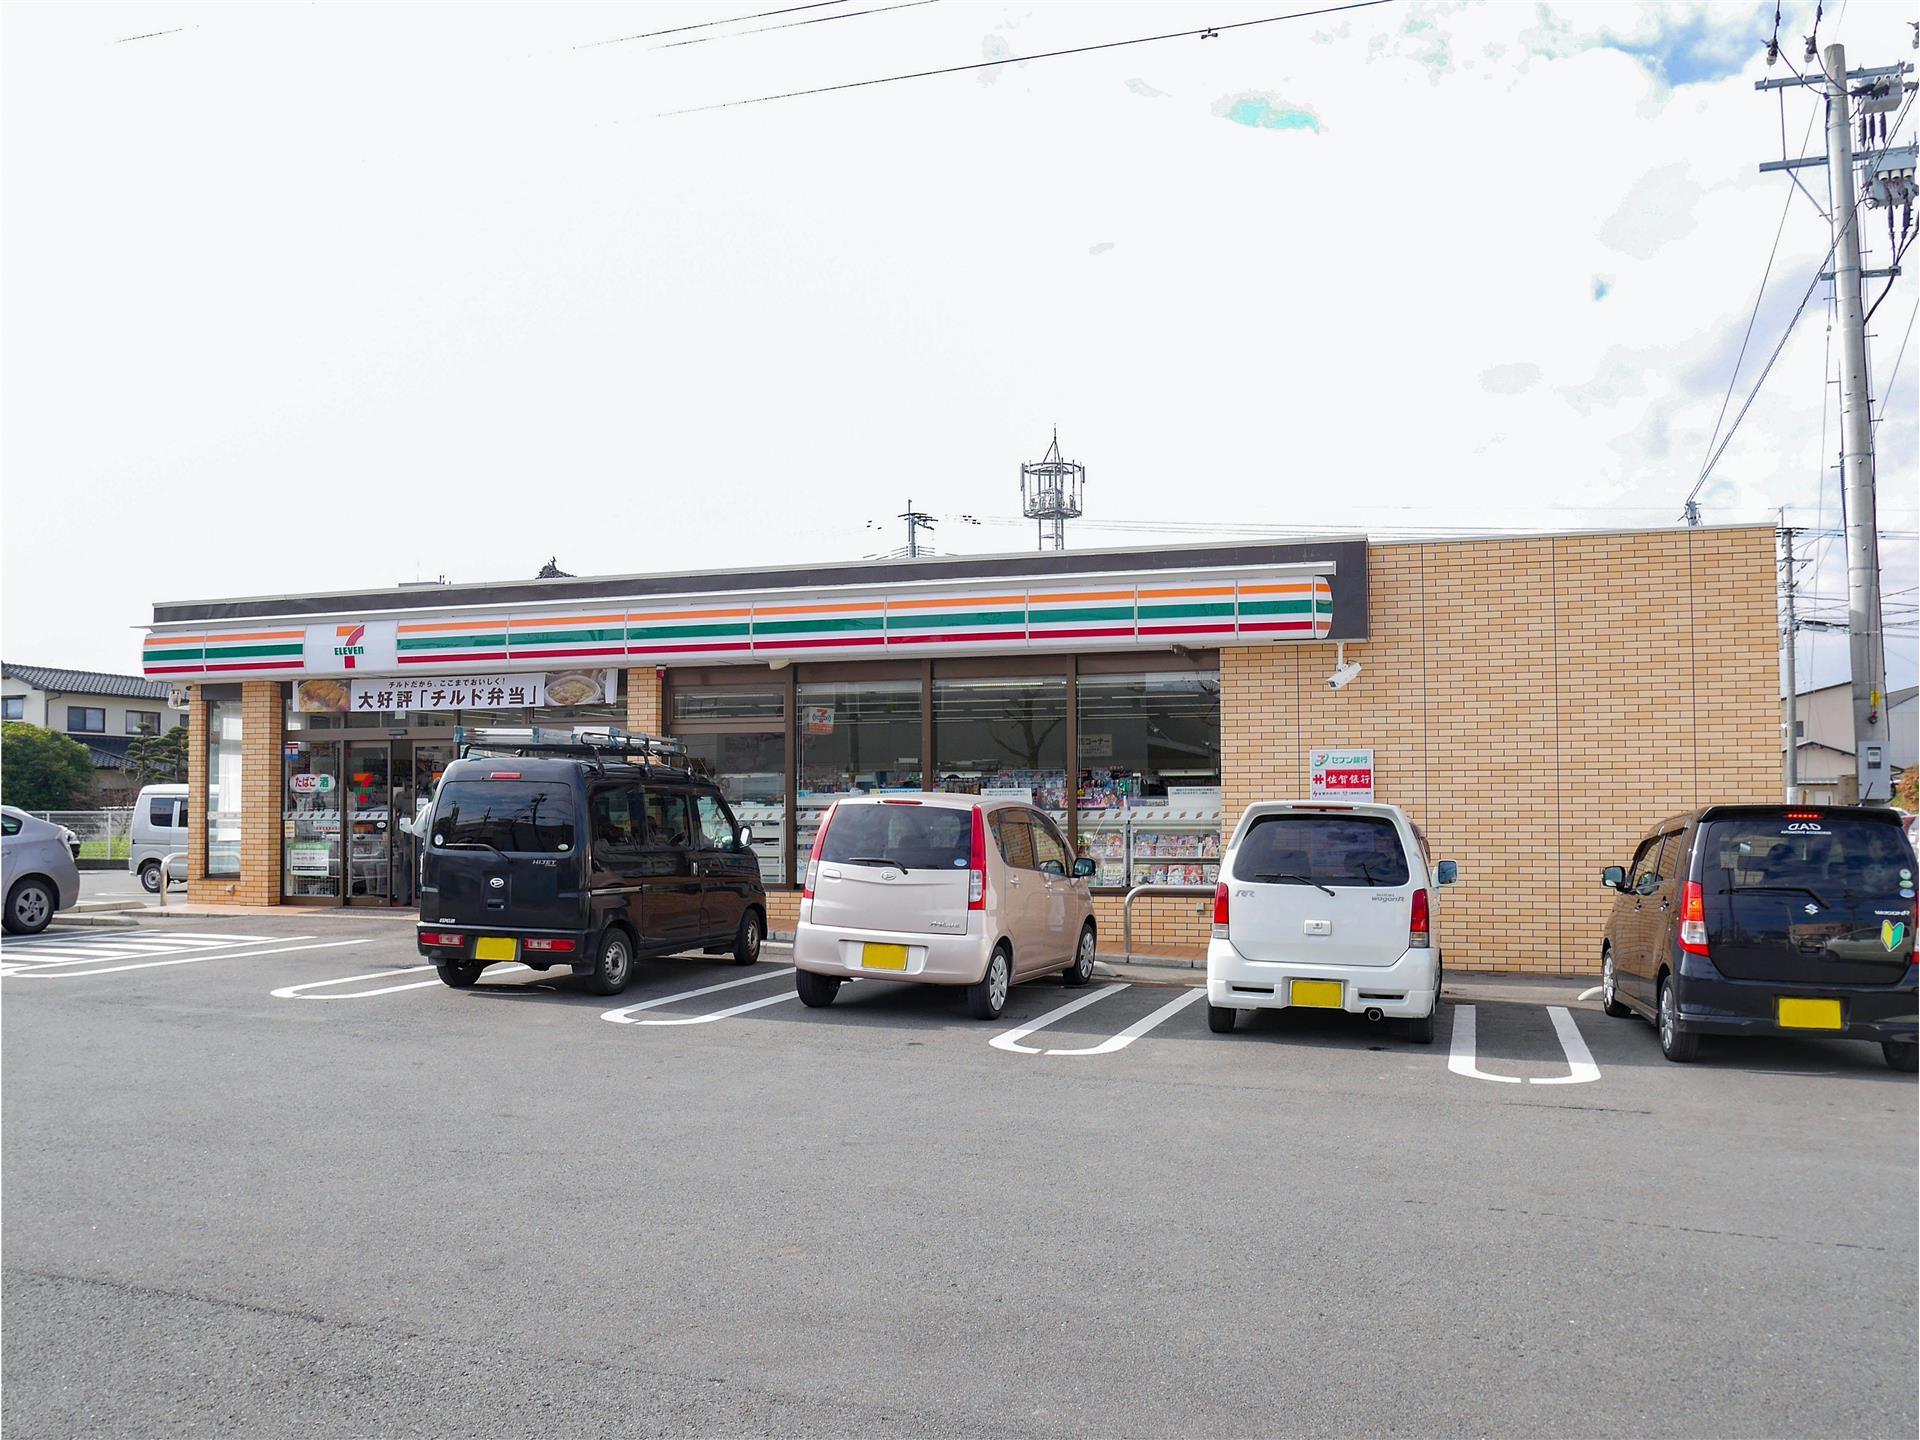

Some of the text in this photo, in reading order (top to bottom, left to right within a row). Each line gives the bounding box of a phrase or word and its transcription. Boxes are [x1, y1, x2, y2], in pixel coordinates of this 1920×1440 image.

[358, 685, 537, 710] 大好評「チルド弁当」
[295, 776, 316, 788] たばこ
[1326, 774, 1371, 785] 佐賀銀行
